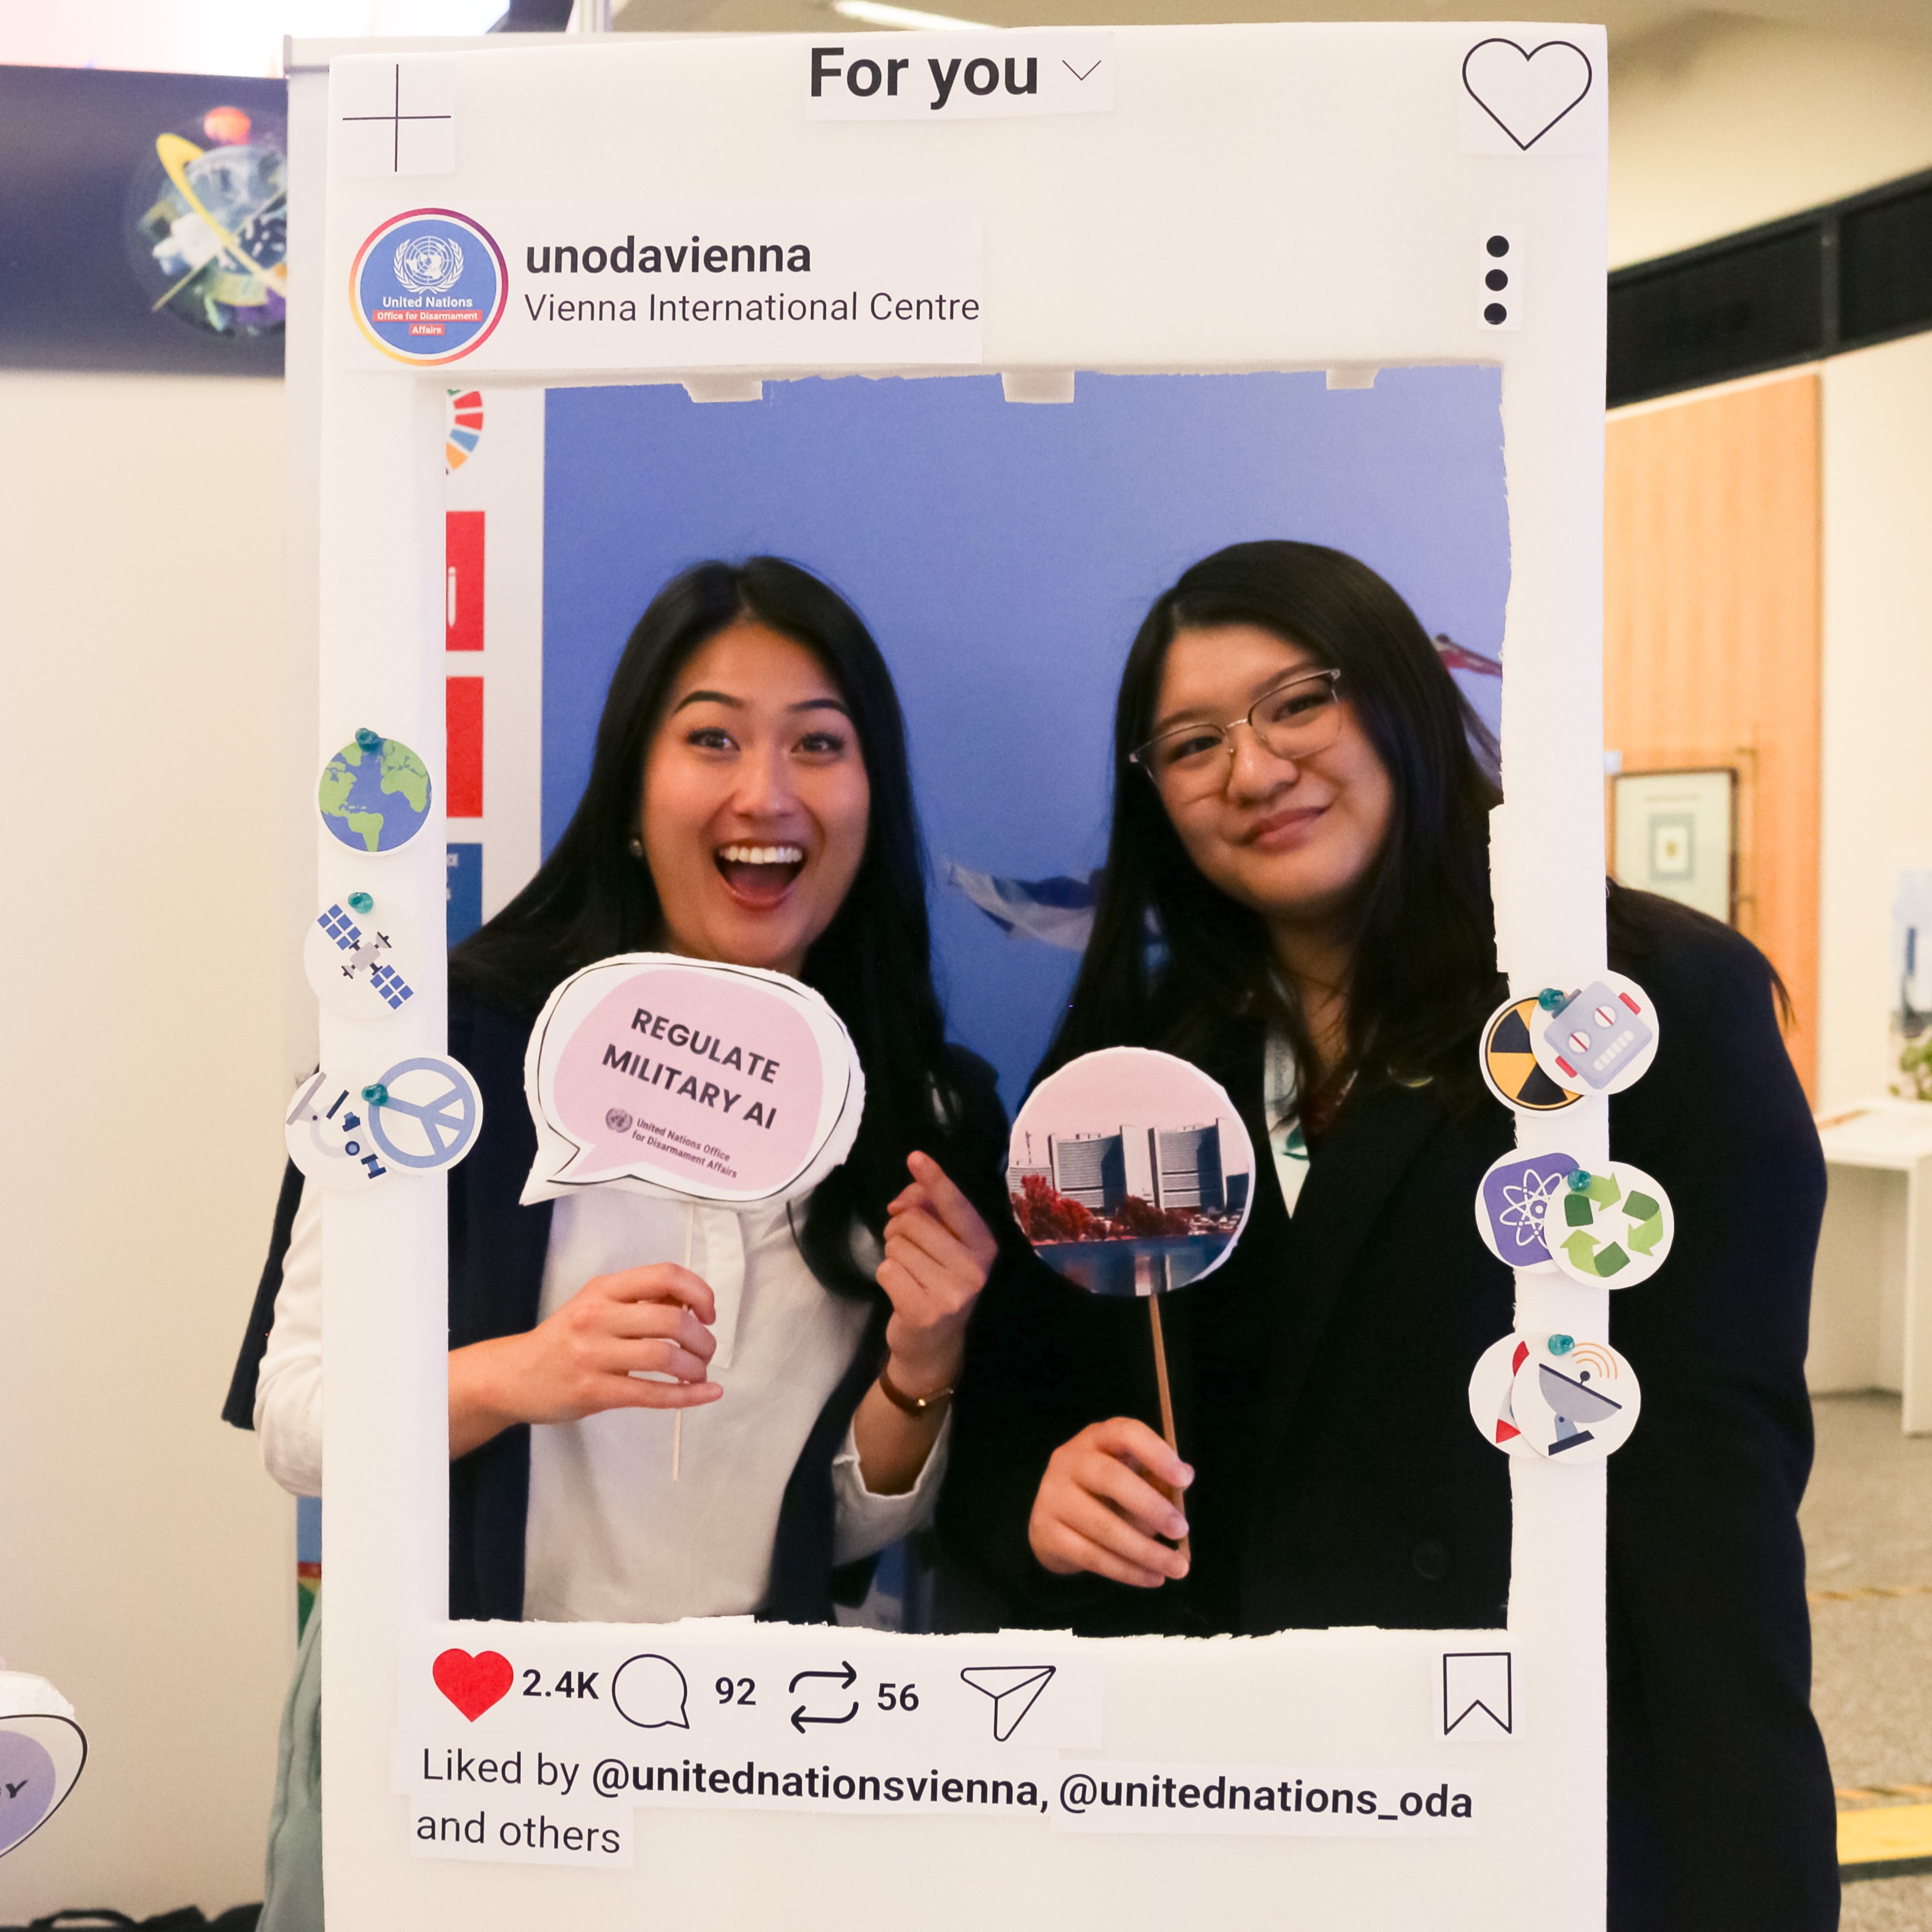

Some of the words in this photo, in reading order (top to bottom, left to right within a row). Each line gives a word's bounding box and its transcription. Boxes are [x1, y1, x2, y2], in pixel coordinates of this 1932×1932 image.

[811, 47, 909, 97] For
[927, 57, 1038, 111] you
[527, 235, 811, 274] unodavienna
[377, 312, 403, 320] Office
[405, 312, 418, 320] for
[420, 312, 478, 320] Disarmament
[383, 296, 422, 308] United
[426, 296, 473, 308] Nations
[524, 293, 636, 321] Vienna
[650, 291, 857, 321] International
[870, 292, 979, 320] Centre
[412, 325, 442, 334] Affairs
[631, 1008, 780, 1084] REGULATE
[602, 1043, 742, 1113] MILITARY
[743, 1102, 777, 1130] AI
[632, 1130, 646, 1142] for
[647, 1136, 706, 1166] Disarmament
[706, 1160, 738, 1179] Affairs
[637, 1118, 667, 1137] United
[667, 1130, 701, 1150] Nations
[703, 1144, 731, 1162] Office
[523, 1669, 599, 1699] 2.4K
[715, 1676, 756, 1706] 92
[877, 1683, 919, 1711] 56
[424, 1748, 521, 1784] Liked
[537, 1752, 580, 1796] by
[593, 1758, 1048, 1814] @unitednationsvienna,
[1060, 1773, 1472, 1820] @unitednations_oda
[417, 1811, 485, 1844] and
[500, 1815, 620, 1854] others
